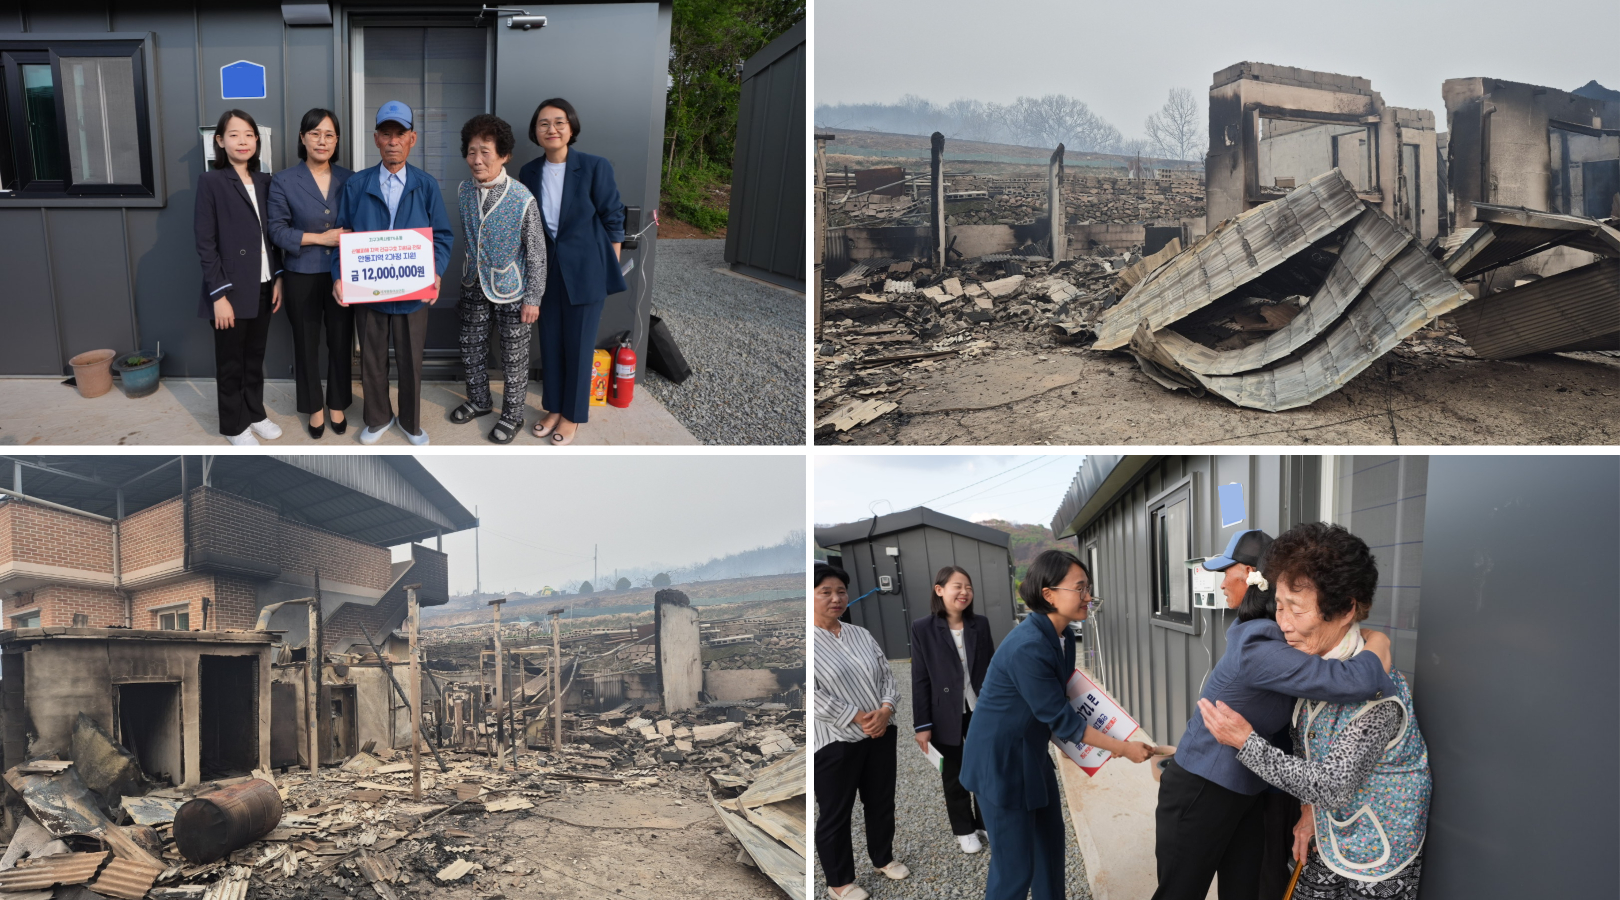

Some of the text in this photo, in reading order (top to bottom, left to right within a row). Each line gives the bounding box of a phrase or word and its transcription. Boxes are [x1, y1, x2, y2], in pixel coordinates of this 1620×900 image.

[358, 254, 384, 262] 안동지역
[403, 251, 416, 259] 지원
[351, 265, 425, 282] 금 12,000,000원
[1087, 693, 1099, 706] 금
[1093, 714, 1108, 730] 안동지
